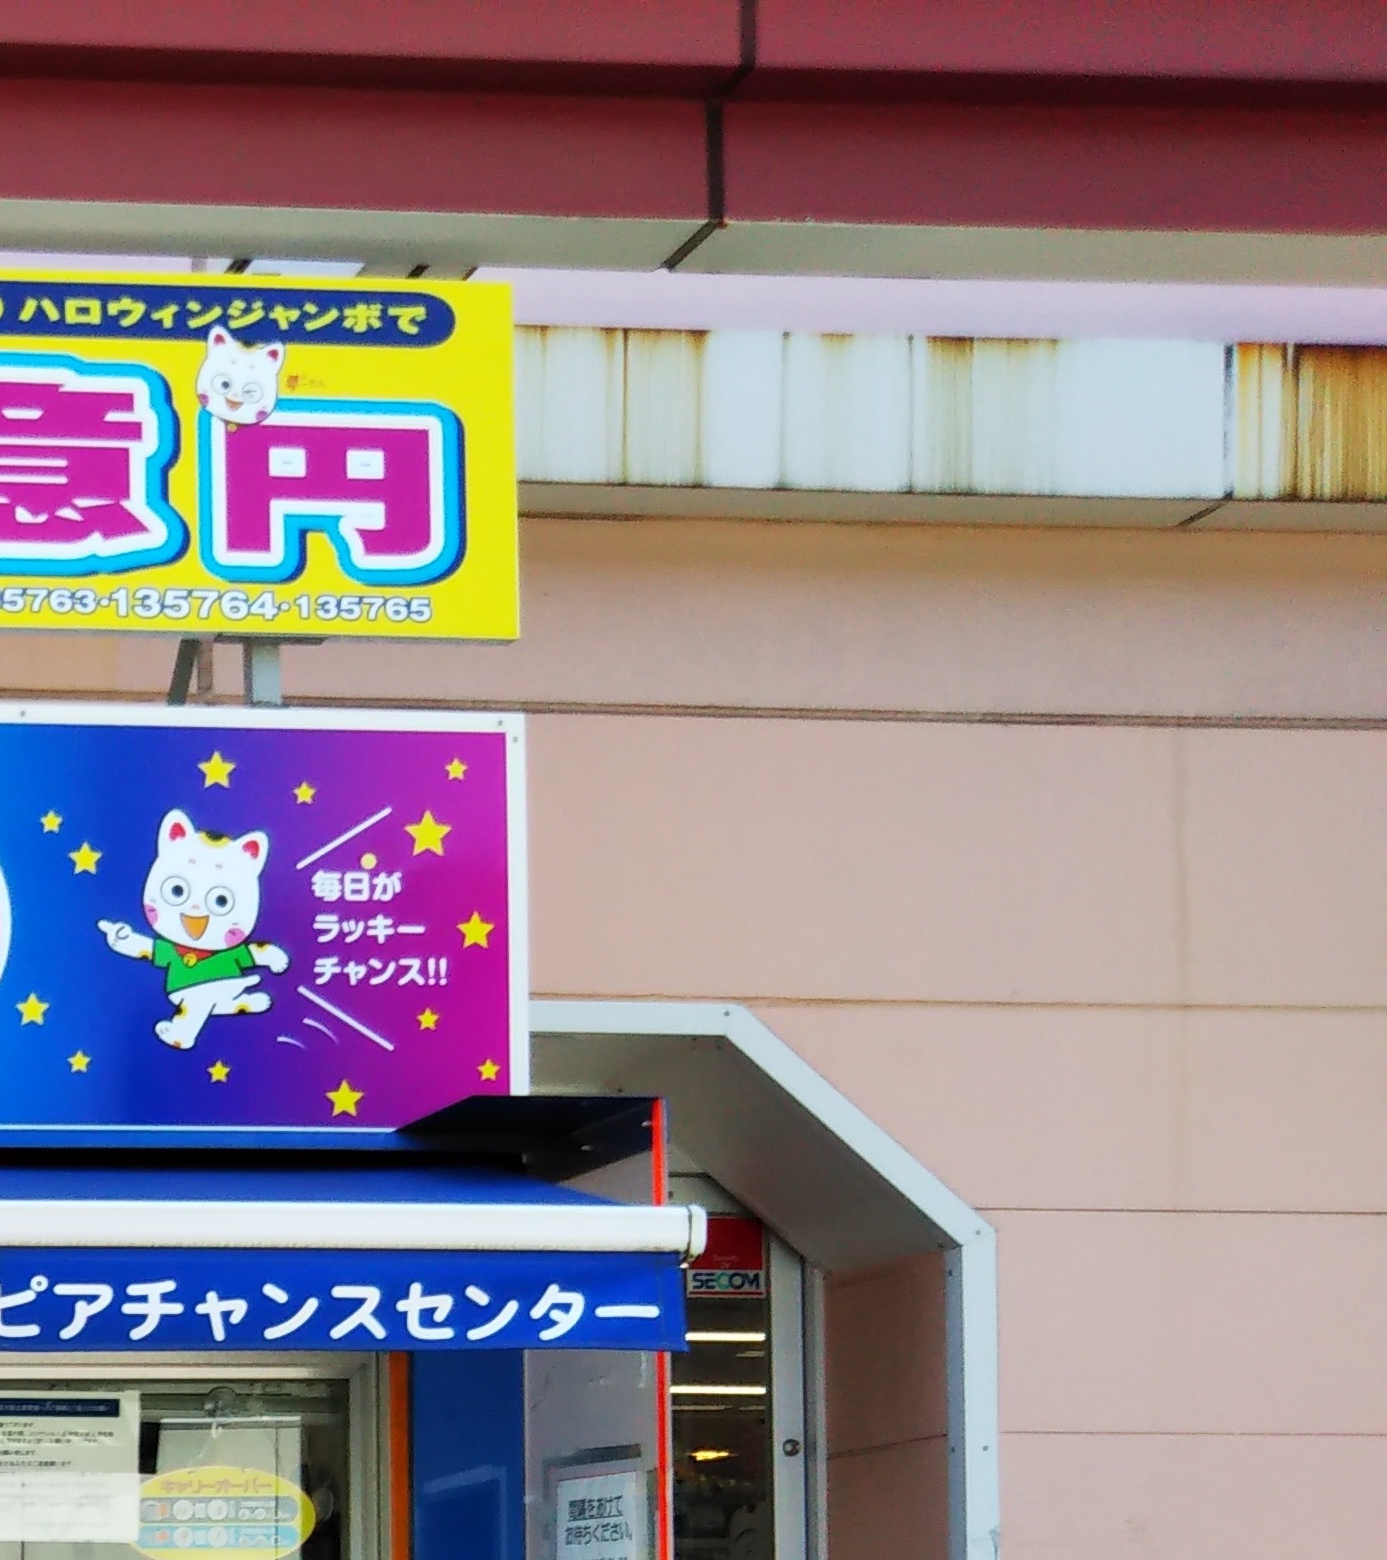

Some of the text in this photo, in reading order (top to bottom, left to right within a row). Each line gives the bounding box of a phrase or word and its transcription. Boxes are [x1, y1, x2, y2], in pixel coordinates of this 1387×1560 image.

[20, 294, 429, 338] ハロウィンジャンボで
[310, 870, 402, 902] 毎日が
[312, 916, 425, 944] ラッキー
[312, 956, 449, 987] チャンス!!
[692, 1271, 761, 1290] SECOM
